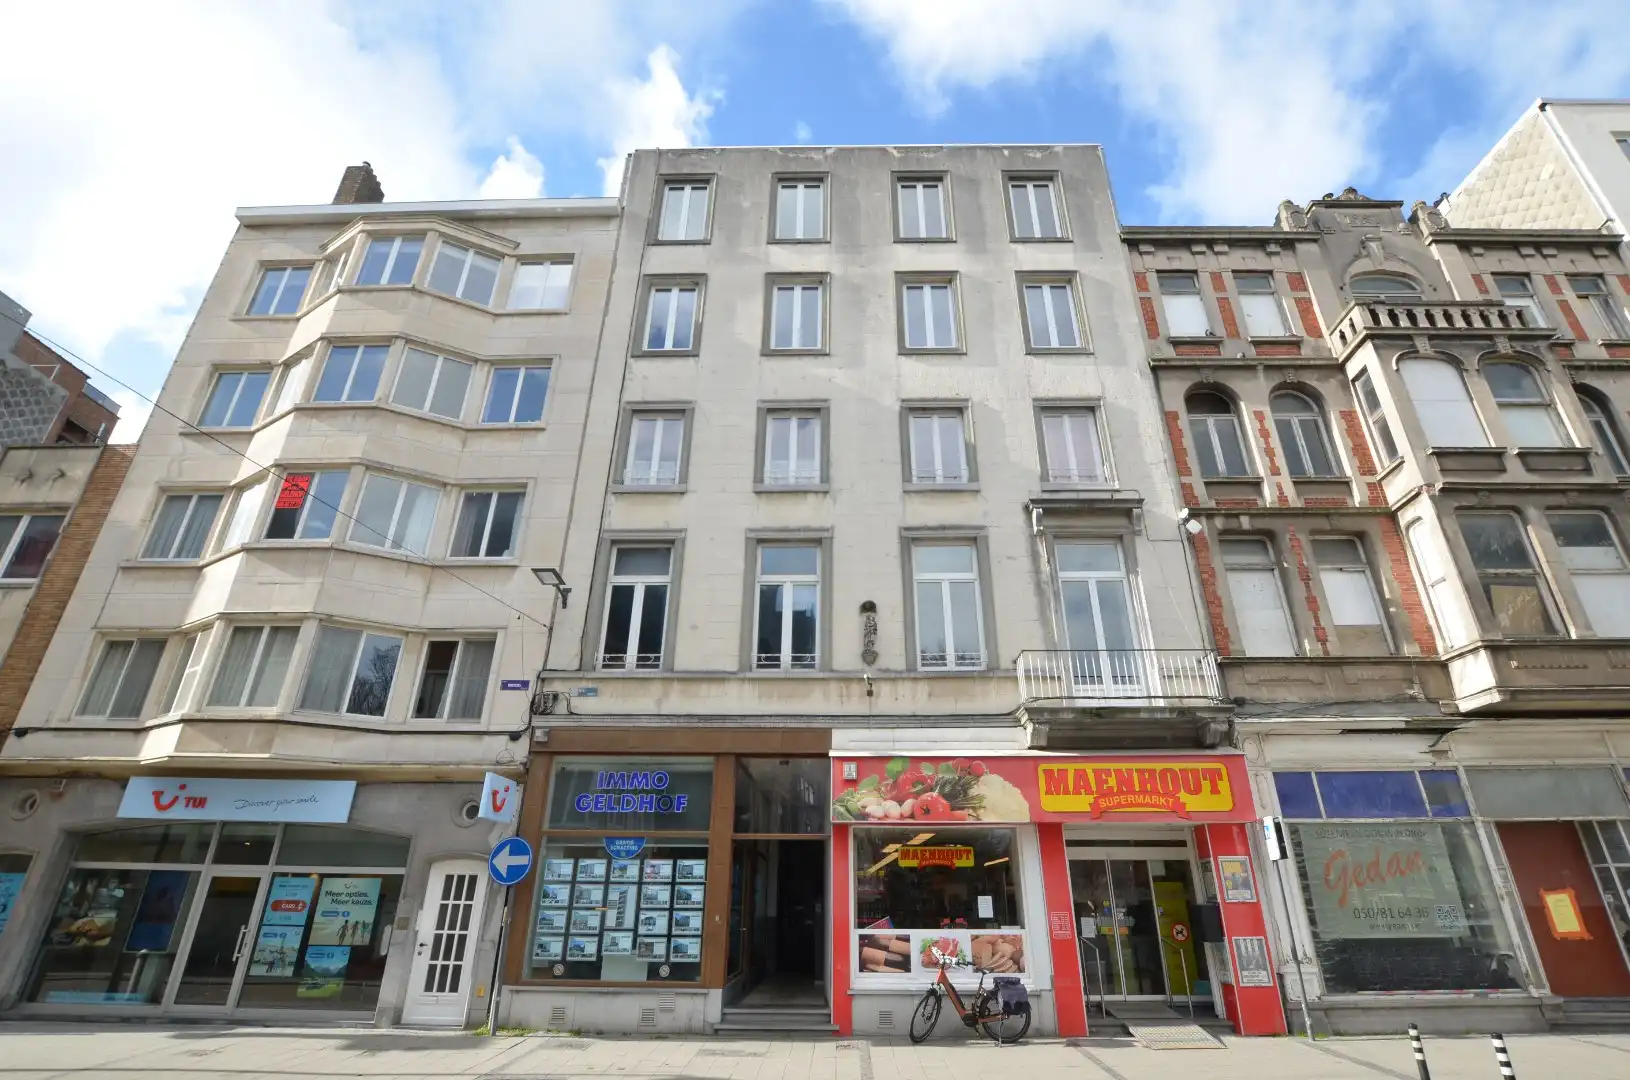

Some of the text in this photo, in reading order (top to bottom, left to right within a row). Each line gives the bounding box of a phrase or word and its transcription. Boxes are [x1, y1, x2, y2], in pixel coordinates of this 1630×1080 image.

[596, 771, 670, 790] IMMO
[1042, 768, 1224, 796] MAENHOUT
[184, 796, 208, 809] TUI
[234, 798, 274, 810] Discover
[296, 794, 319, 804] smile
[575, 793, 688, 813] GELDHOF
[1098, 795, 1175, 809] SUPERMARKT
[900, 848, 972, 860] MAENHOUT
[1323, 844, 1426, 908] Gedan
[325, 890, 369, 899] Meer opties.
[330, 898, 350, 906] Meer
[1353, 907, 1395, 920] 050/81
[1397, 907, 1413, 919] 64
